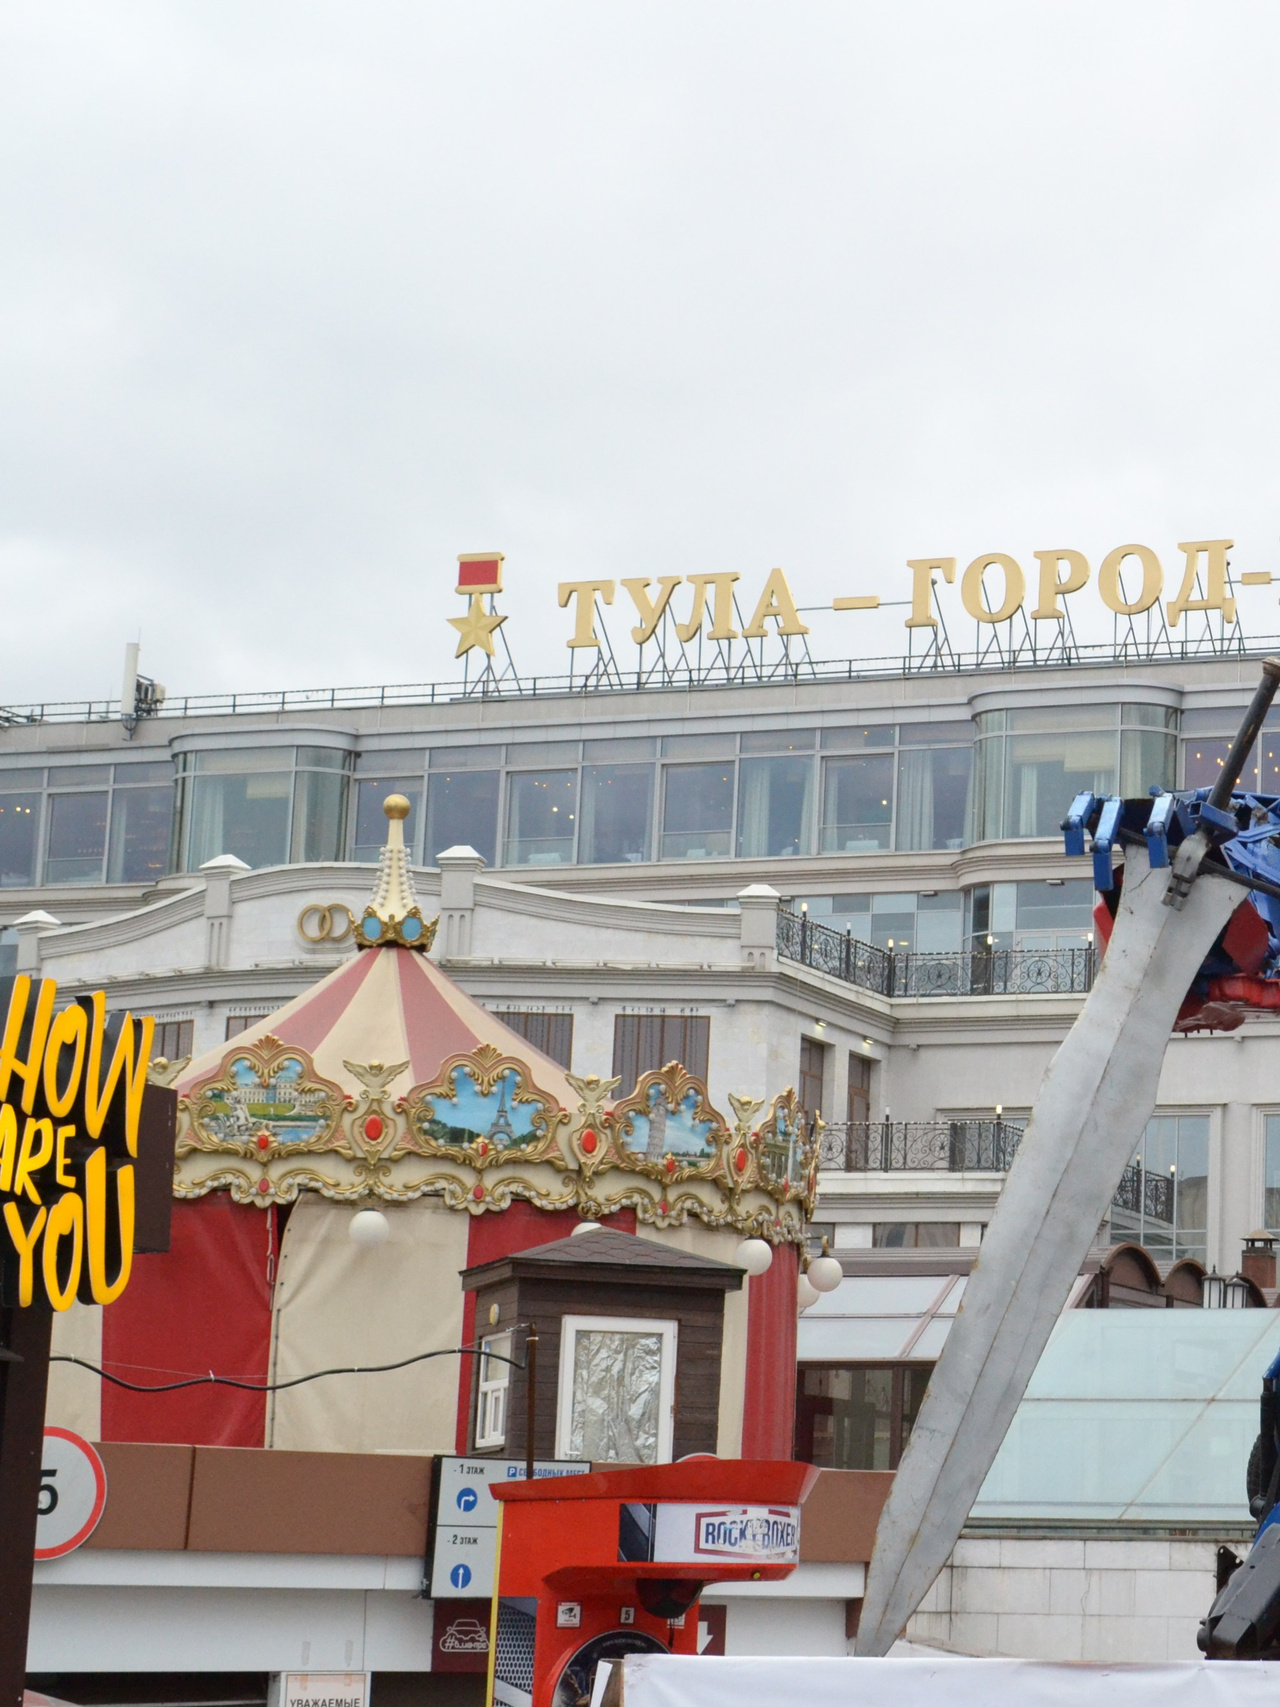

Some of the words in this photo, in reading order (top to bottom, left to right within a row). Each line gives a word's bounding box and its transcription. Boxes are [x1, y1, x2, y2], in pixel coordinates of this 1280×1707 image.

[557, 567, 810, 649] ТУЛА
[0, 974, 155, 1158] HOW
[3, 1146, 135, 1312] YOU
[518, 1468, 564, 1478] СВБОДНЫХ
[290, 1698, 361, 1707] УВАЖАЕМЫЕ
